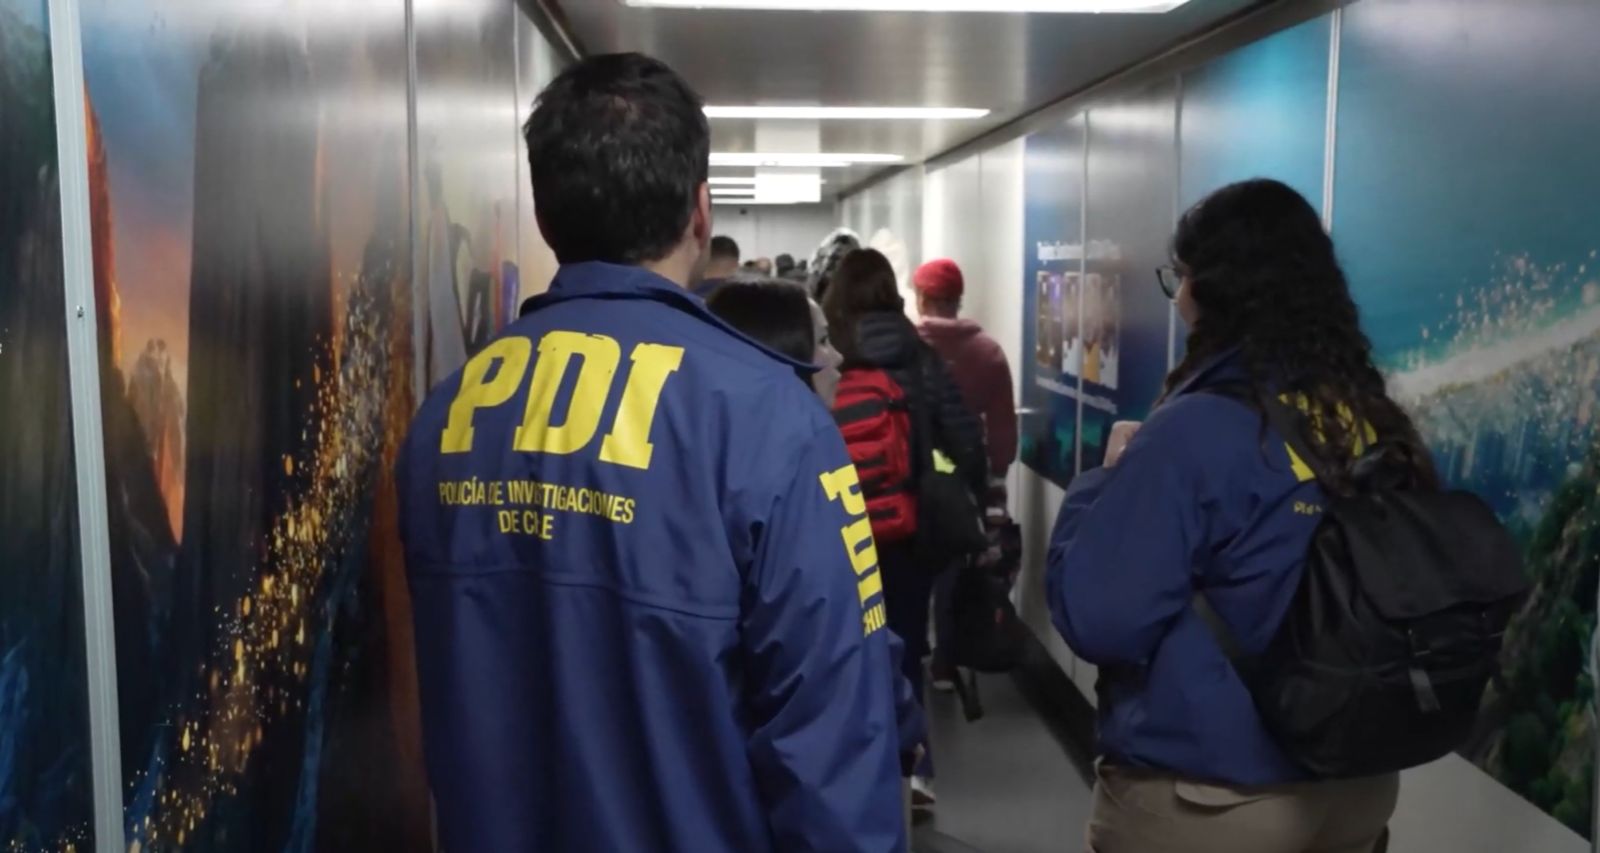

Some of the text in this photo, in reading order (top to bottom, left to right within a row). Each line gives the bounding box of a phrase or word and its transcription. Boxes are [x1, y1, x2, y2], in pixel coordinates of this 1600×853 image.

[440, 330, 685, 470] PDI
[439, 475, 636, 524] POLICÍA DE INVTIGACIONES
[497, 510, 555, 540] DE CHE
[818, 463, 882, 609] PDI
[863, 602, 886, 638] HIL
